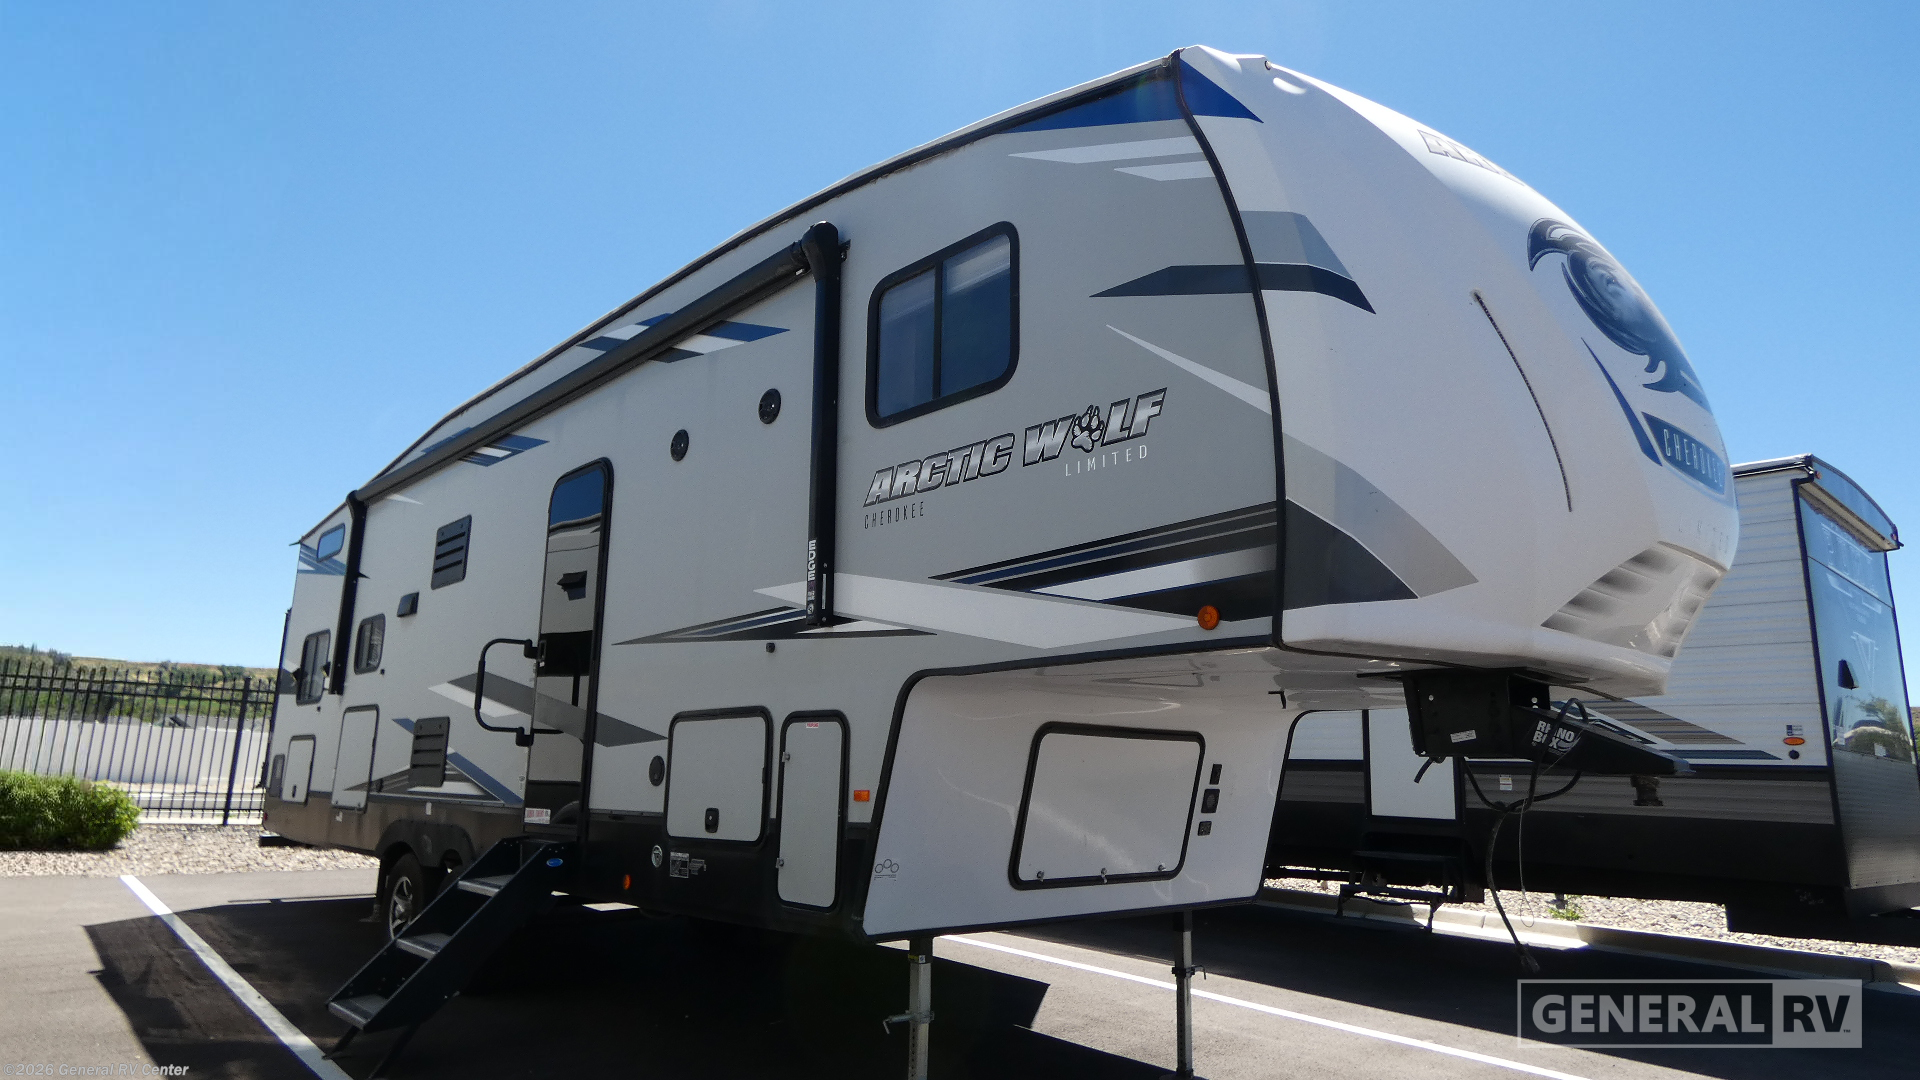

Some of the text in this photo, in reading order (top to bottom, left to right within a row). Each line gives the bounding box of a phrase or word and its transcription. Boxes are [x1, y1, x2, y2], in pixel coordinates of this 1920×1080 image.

[863, 432, 1015, 507] ARCTIC
[1065, 445, 1148, 477] LIMITED
[864, 501, 925, 529] CHEROKEE
[807, 539, 817, 581] EDGE
[1536, 720, 1575, 742] RHNO
